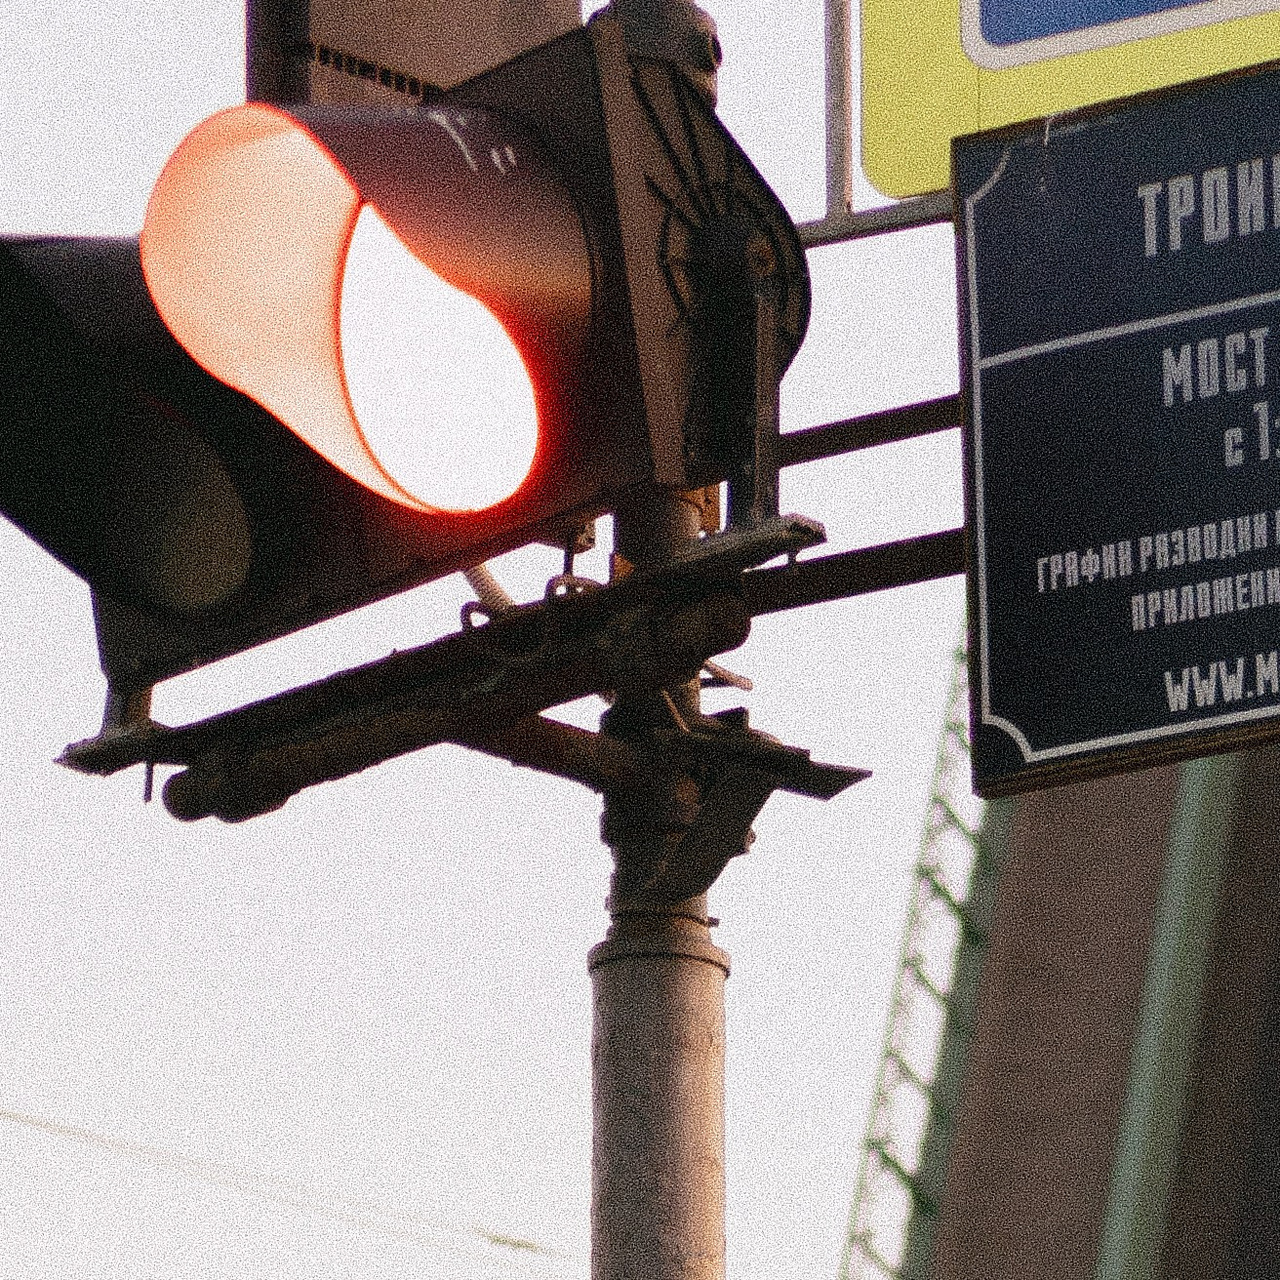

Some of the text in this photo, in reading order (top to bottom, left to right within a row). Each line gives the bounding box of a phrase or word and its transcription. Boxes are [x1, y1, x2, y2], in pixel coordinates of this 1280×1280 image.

[1160, 328, 1268, 406] МОСТ
[1037, 540, 1131, 593] ГРАФИК
[1140, 513, 1268, 571] РАЗВОДКИ
